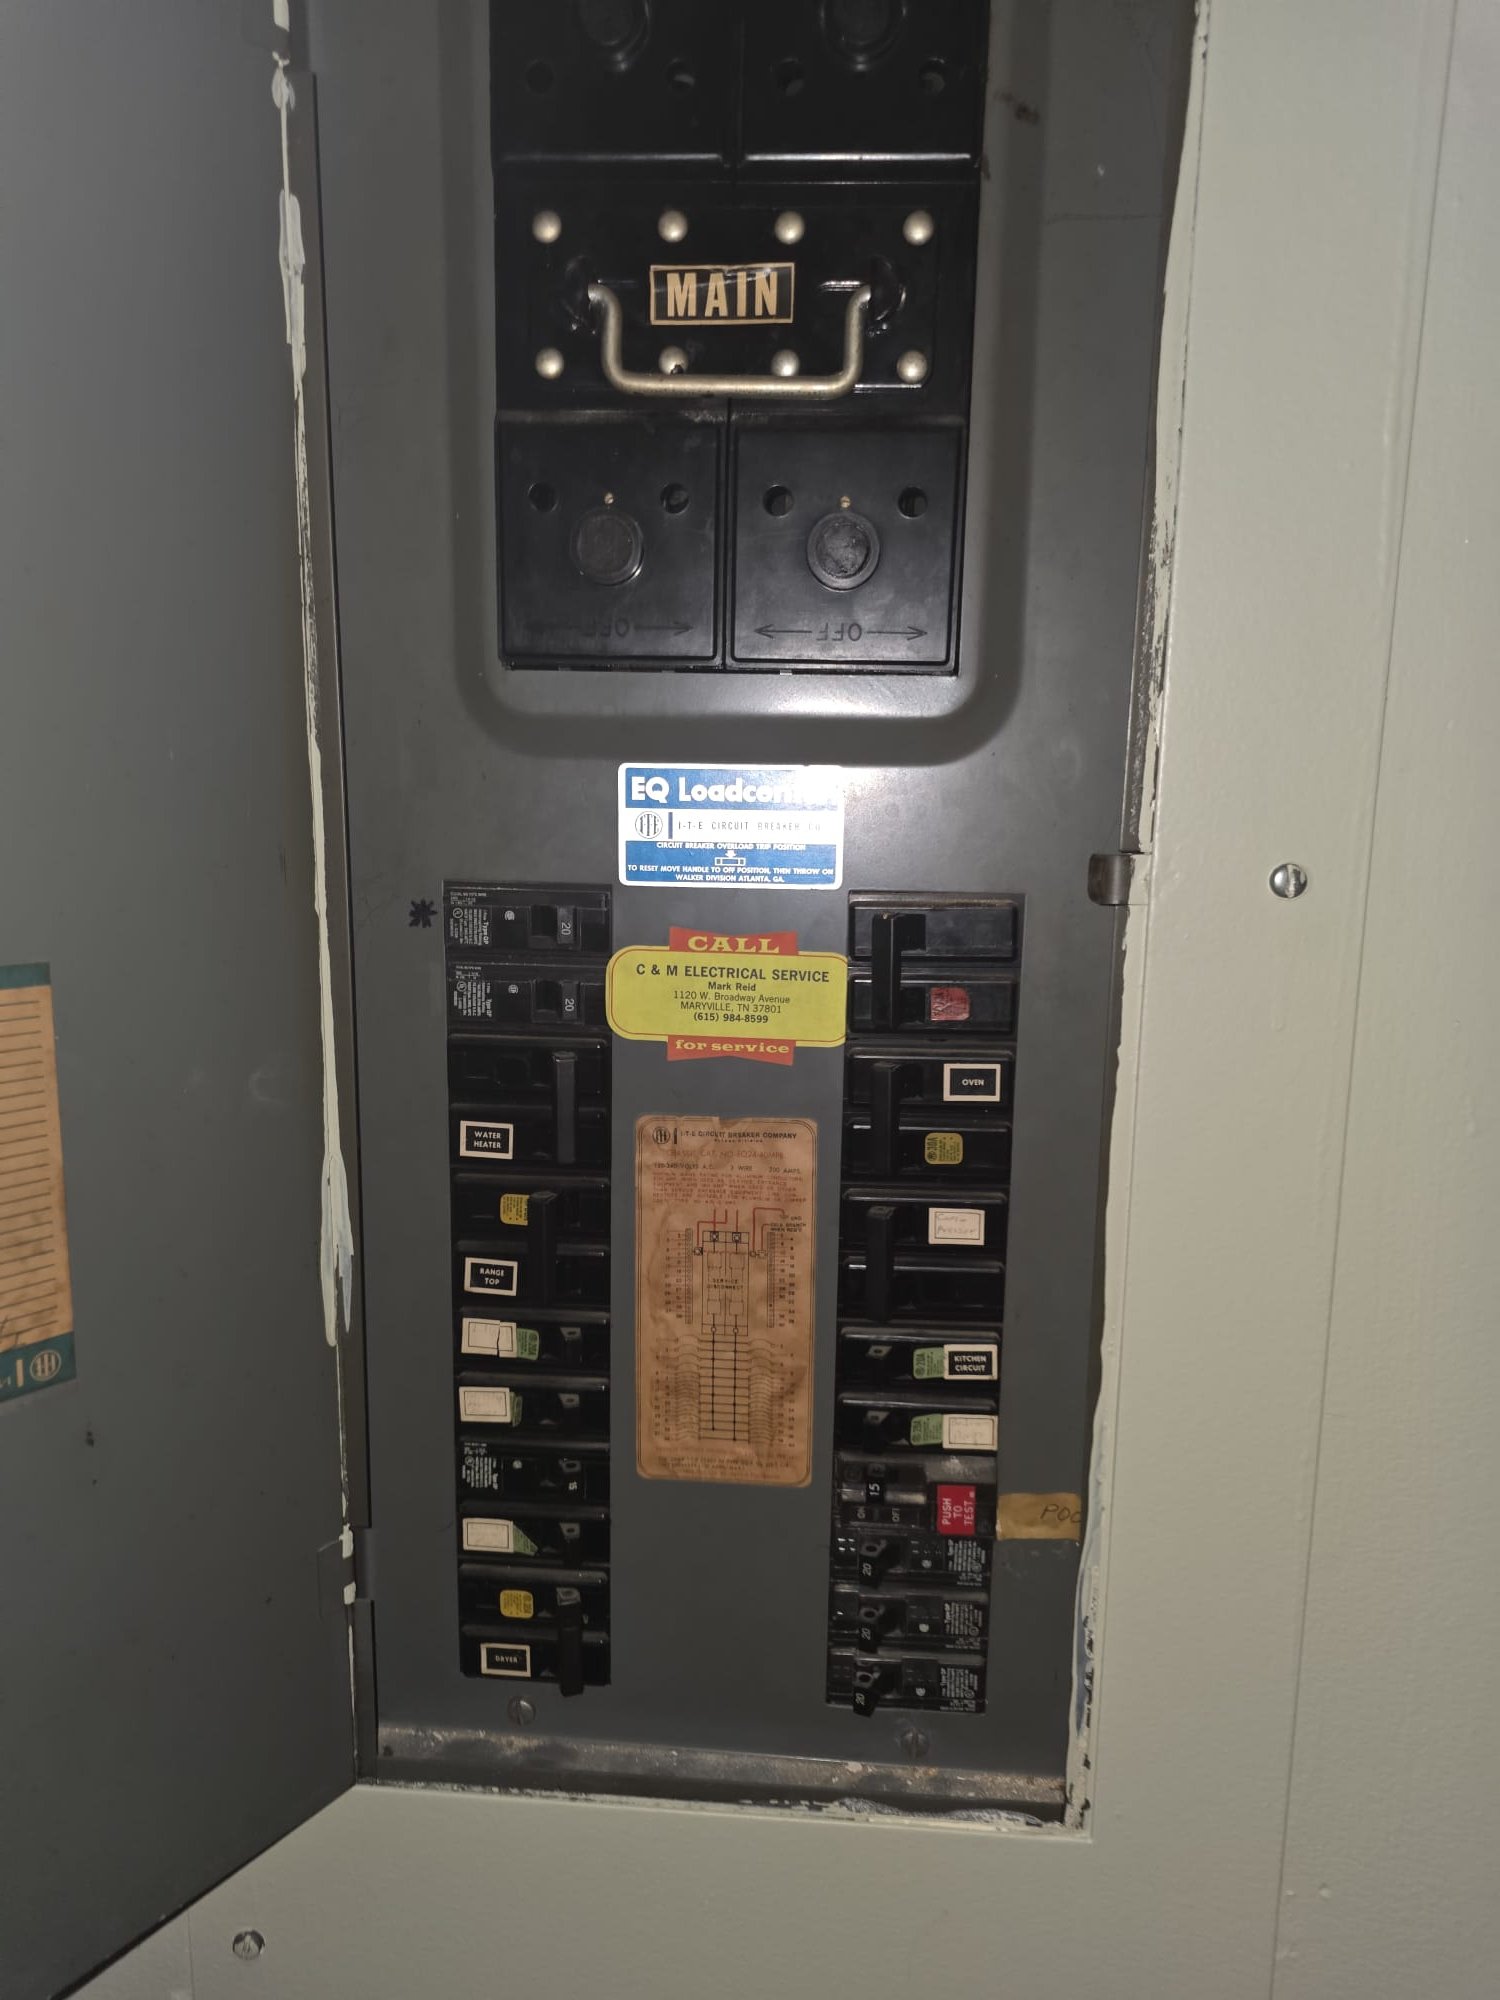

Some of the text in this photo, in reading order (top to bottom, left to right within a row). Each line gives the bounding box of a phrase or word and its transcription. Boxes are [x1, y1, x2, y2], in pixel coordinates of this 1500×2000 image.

[665, 269, 779, 318] MAIN
[816, 622, 863, 642] OFF
[631, 776, 670, 804] EQ
[678, 821, 703, 830] I-T-E
[711, 821, 748, 830] CIRCUIT
[561, 922, 571, 936] 20
[687, 936, 780, 954] CALL
[636, 963, 829, 983] C & M ELECTRICAL SERVICE
[708, 981, 756, 992] Mark Reid
[674, 990, 790, 1004] 1120 W. Broadway Avenue
[565, 999, 574, 1012] 20
[680, 1001, 781, 1014] MARYVILLE, TN 37801
[693, 1012, 768, 1024] (615) 984-8599
[675, 1039, 789, 1053] for service
[961, 1078, 985, 1087] OVEN
[474, 1130, 501, 1139] WATER
[474, 1140, 502, 1149] HEATER
[479, 1267, 505, 1277] RANGE
[485, 1277, 500, 1286] TOP
[953, 1355, 987, 1363] KITCHEN
[954, 1364, 986, 1372] CIRCUIT
[868, 1483, 880, 1497] 15
[942, 1498, 952, 1526] PUSH
[953, 1504, 963, 1518] TO
[964, 1500, 975, 1526] TEST
[862, 1563, 872, 1577] 20
[861, 1627, 871, 1641] 20
[495, 1655, 518, 1664] DRYER
